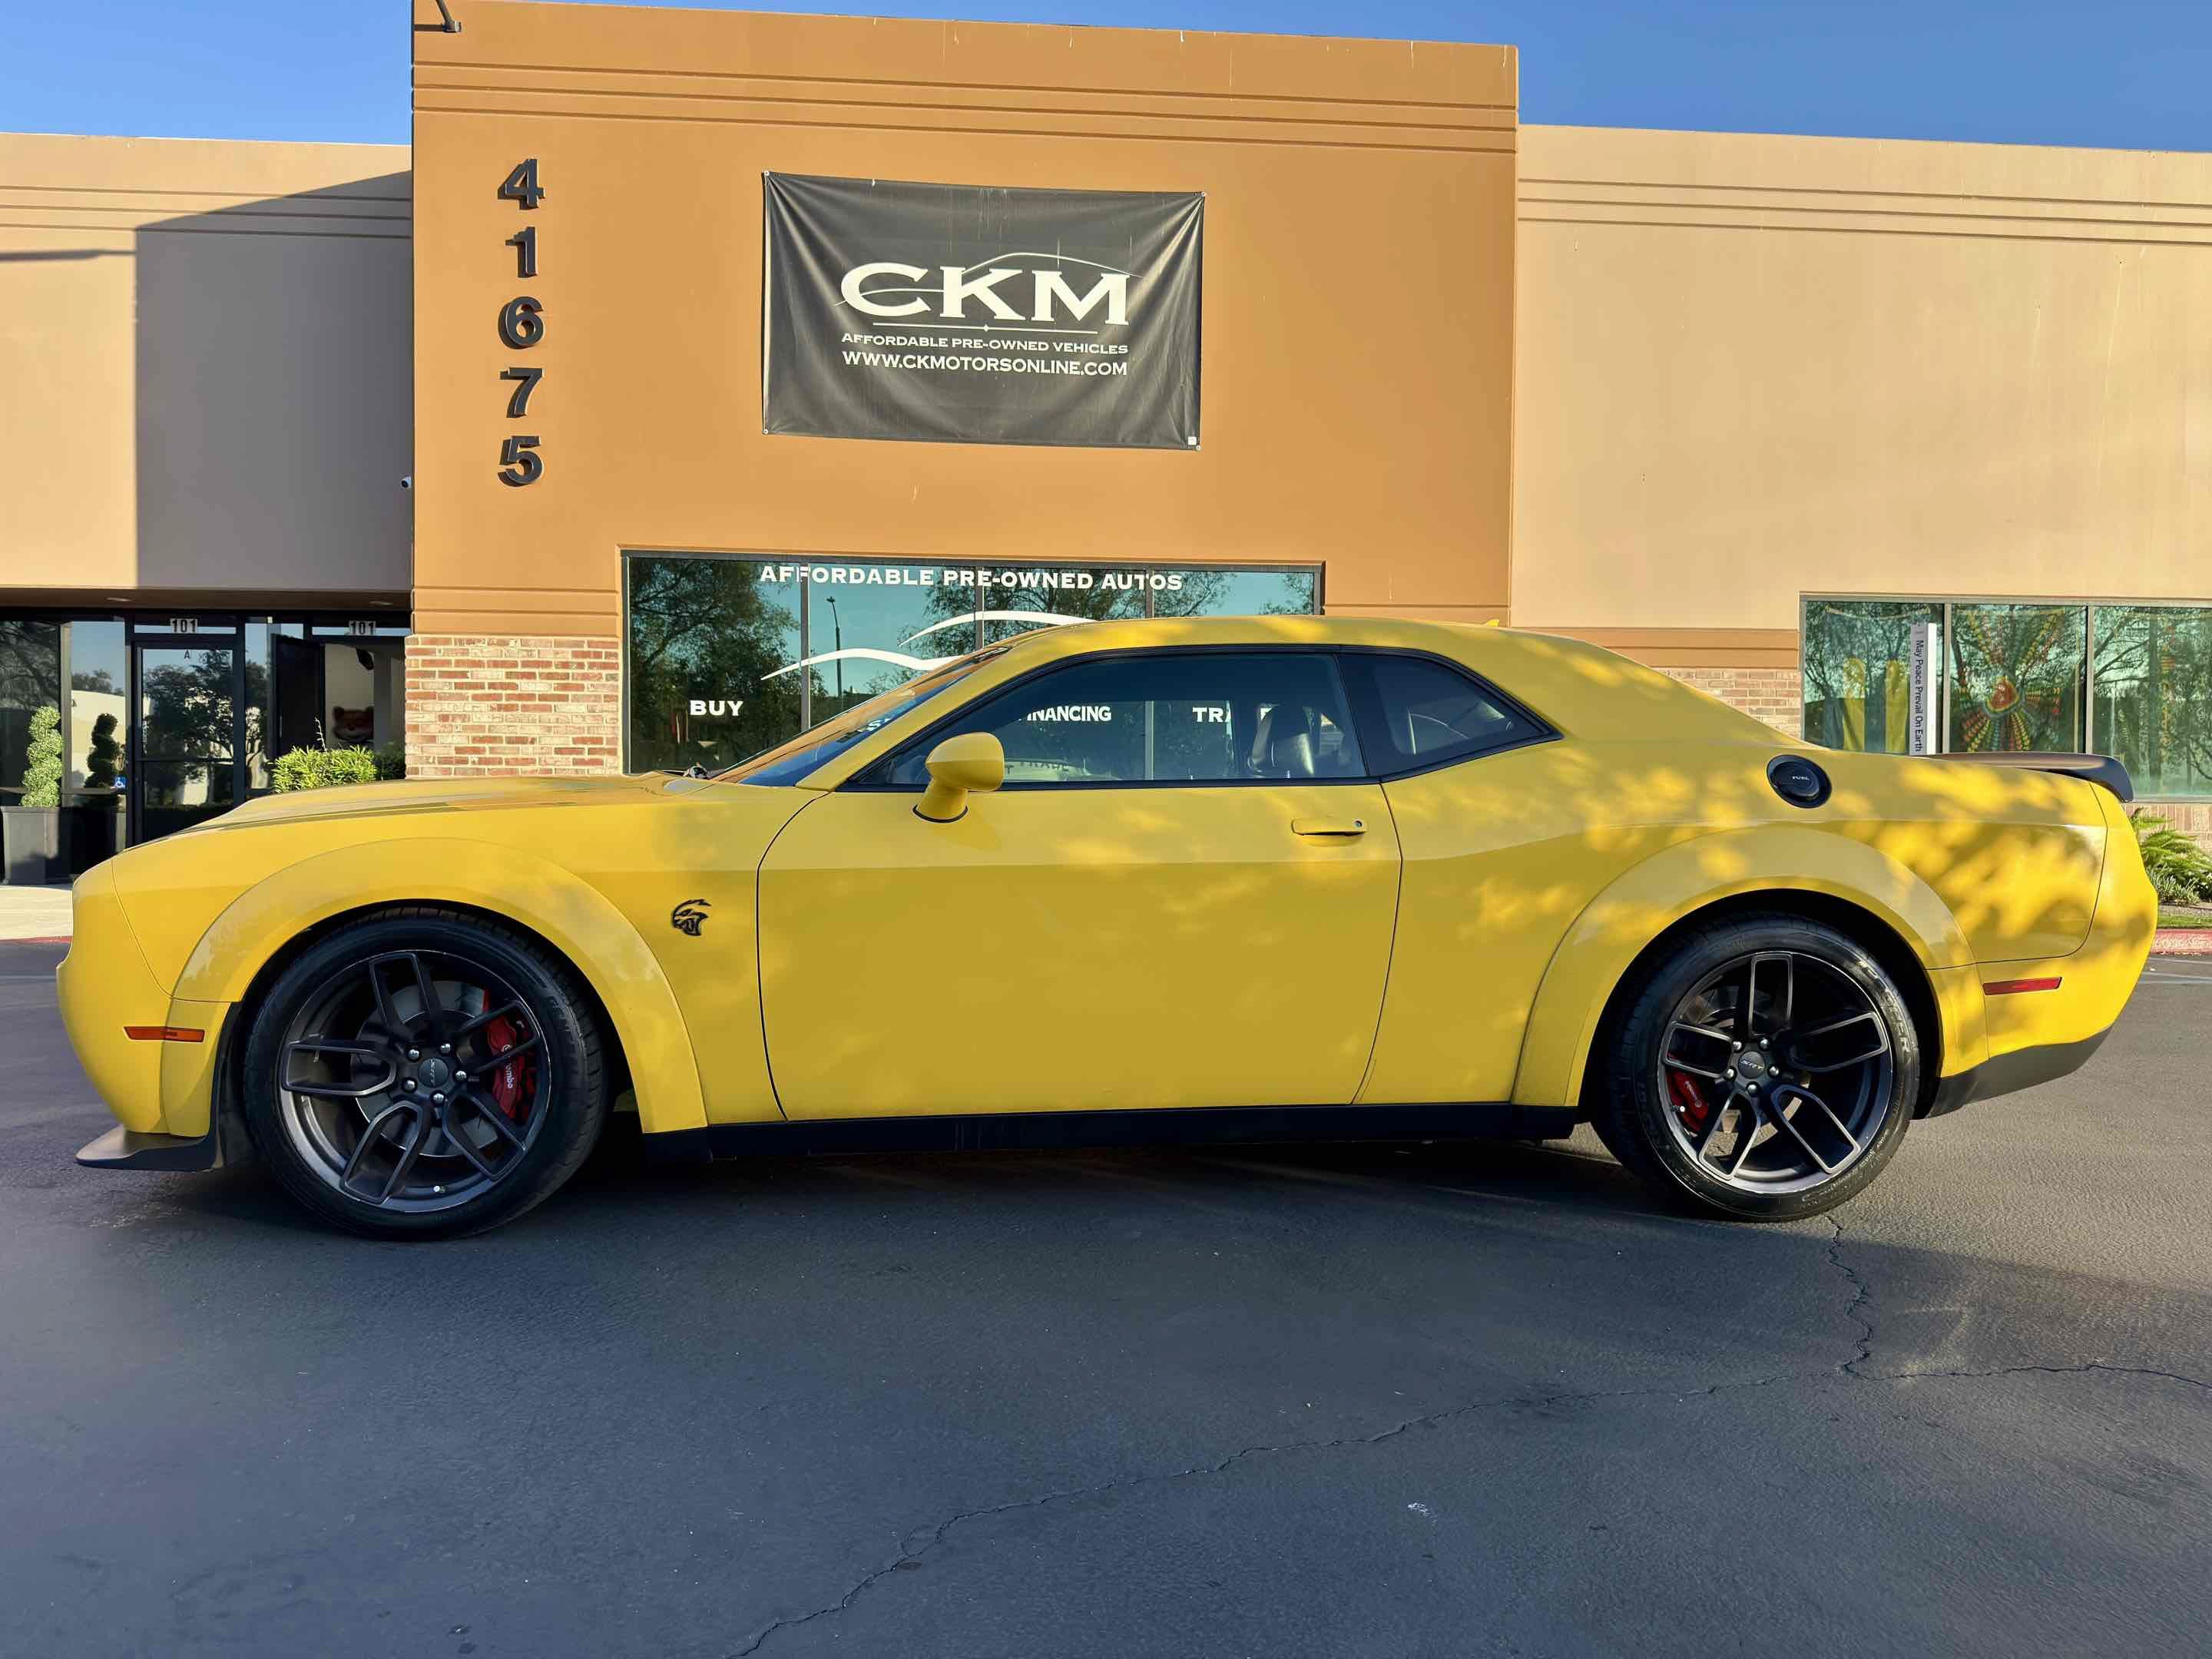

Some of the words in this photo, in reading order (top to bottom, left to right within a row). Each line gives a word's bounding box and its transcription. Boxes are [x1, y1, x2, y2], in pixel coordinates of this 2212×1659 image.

[840, 262, 1131, 326] CKM
[499, 158, 546, 487] 41675
[842, 333, 949, 347] AFFORDABLE
[952, 338, 1049, 352] PRE-OWNED
[1052, 343, 1129, 355] VEHICLES
[842, 350, 1128, 376] WWW.CKMOTORSONLINE.COM
[760, 565, 934, 586] AFFORDABLE
[943, 570, 1094, 590] PRE-OWNED
[1101, 573, 1183, 591] AUTOS
[171, 619, 197, 633] 101
[350, 621, 374, 635] 101
[1913, 640, 1924, 657] May
[1915, 659, 1924, 684] Peace
[689, 700, 744, 717] BUY
[1915, 687, 1923, 714] Prevail
[1915, 716, 1923, 727] On
[1915, 729, 1924, 752] Earth
